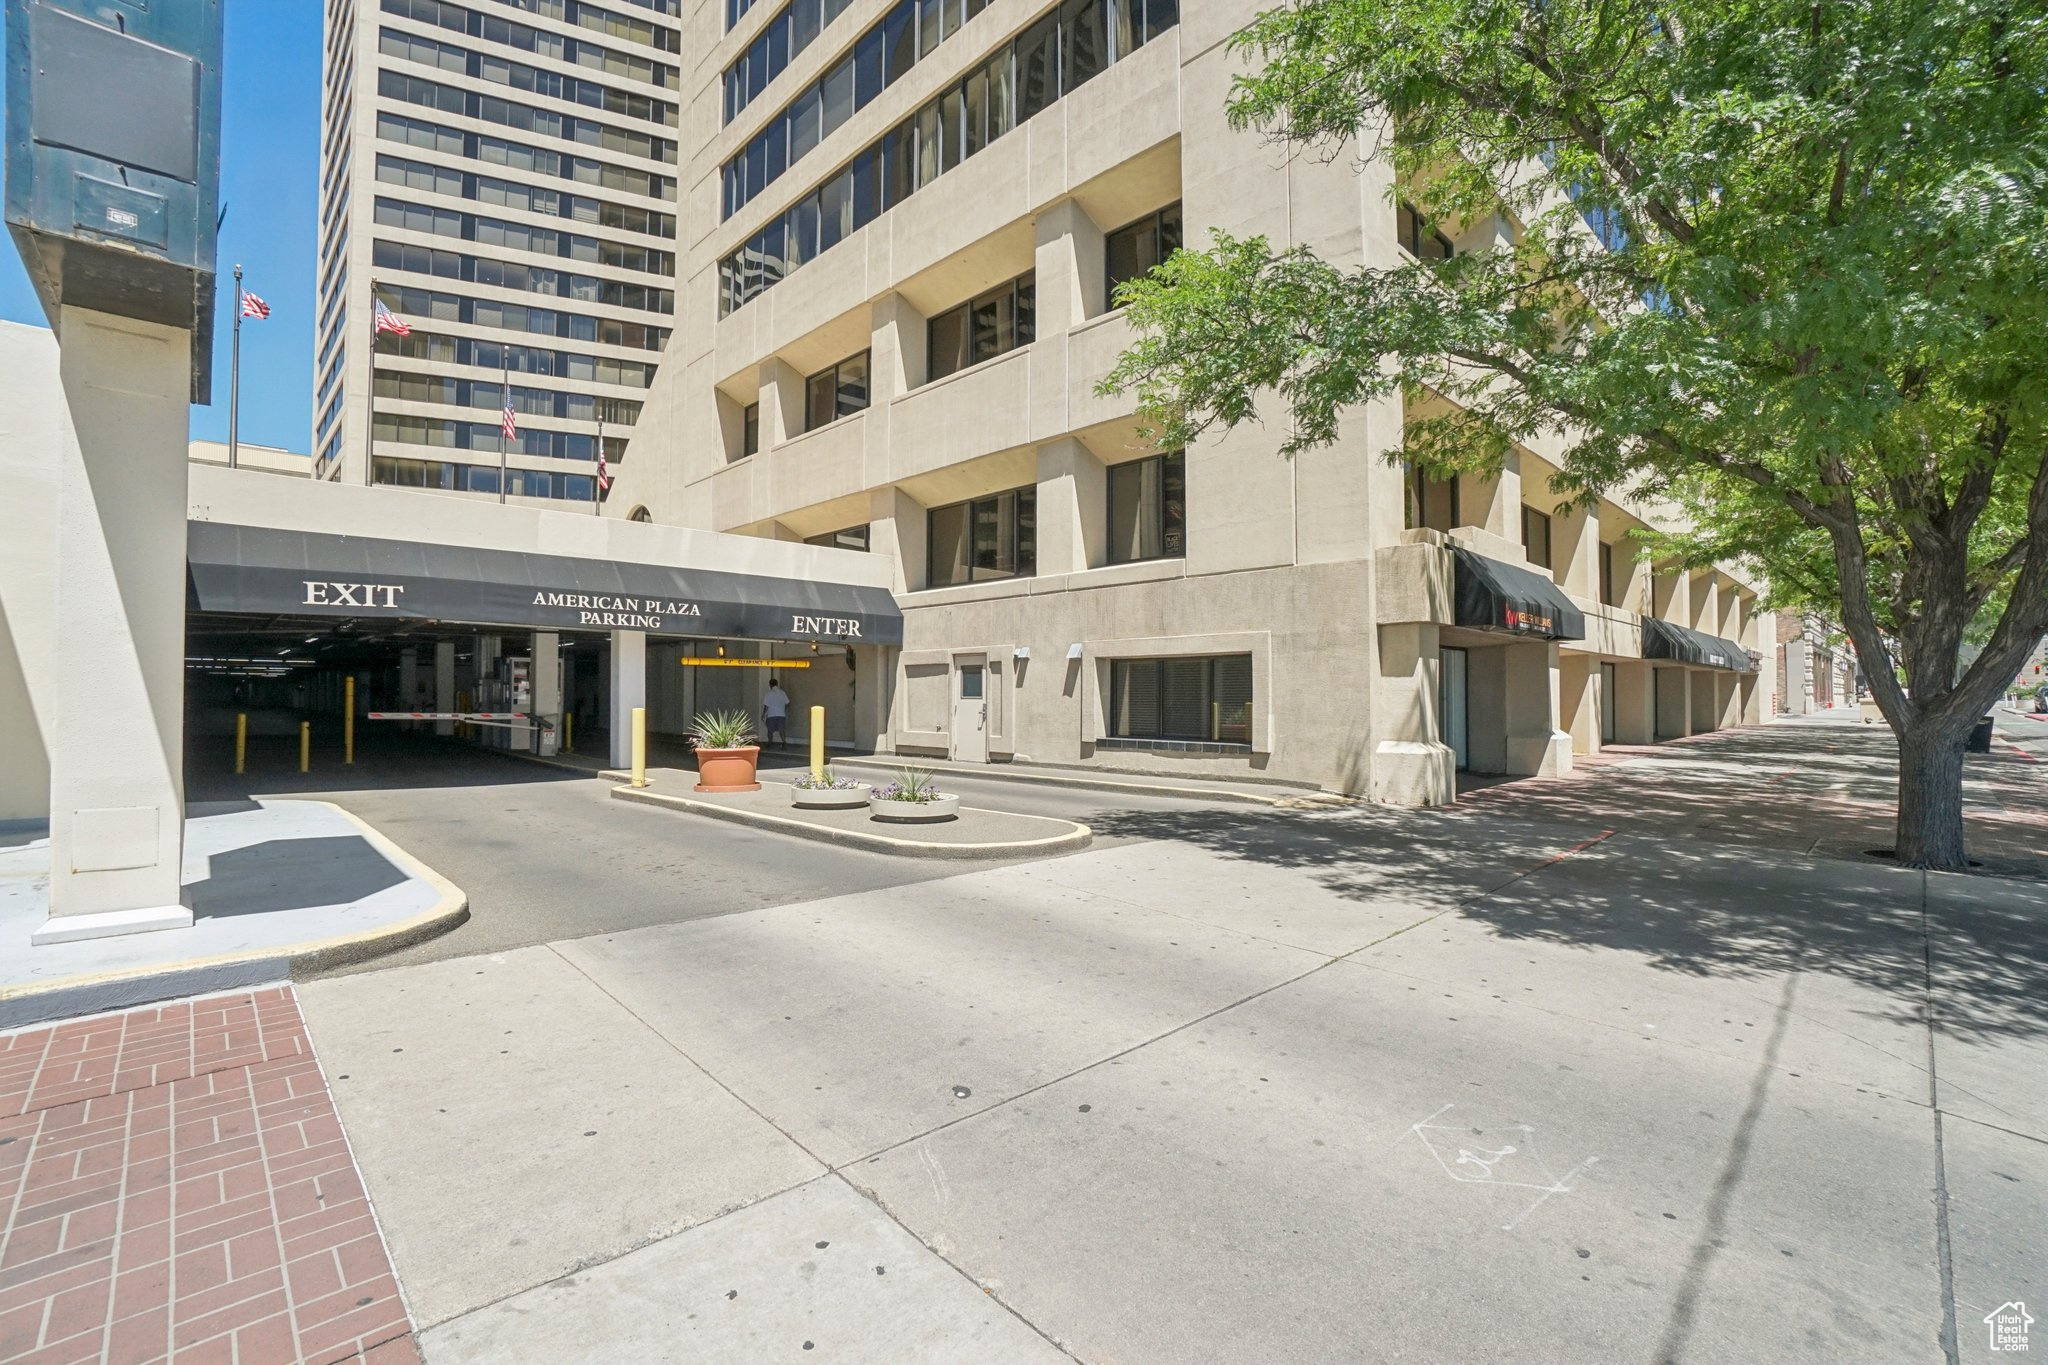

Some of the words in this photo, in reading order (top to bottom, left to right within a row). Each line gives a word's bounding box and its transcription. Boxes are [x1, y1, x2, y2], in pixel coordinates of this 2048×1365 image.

[302, 581, 404, 608] EXIT
[532, 592, 639, 612] AMERICAN
[645, 601, 701, 616] PLAZA
[580, 611, 661, 628] PARKING
[791, 615, 863, 637] ENTER
